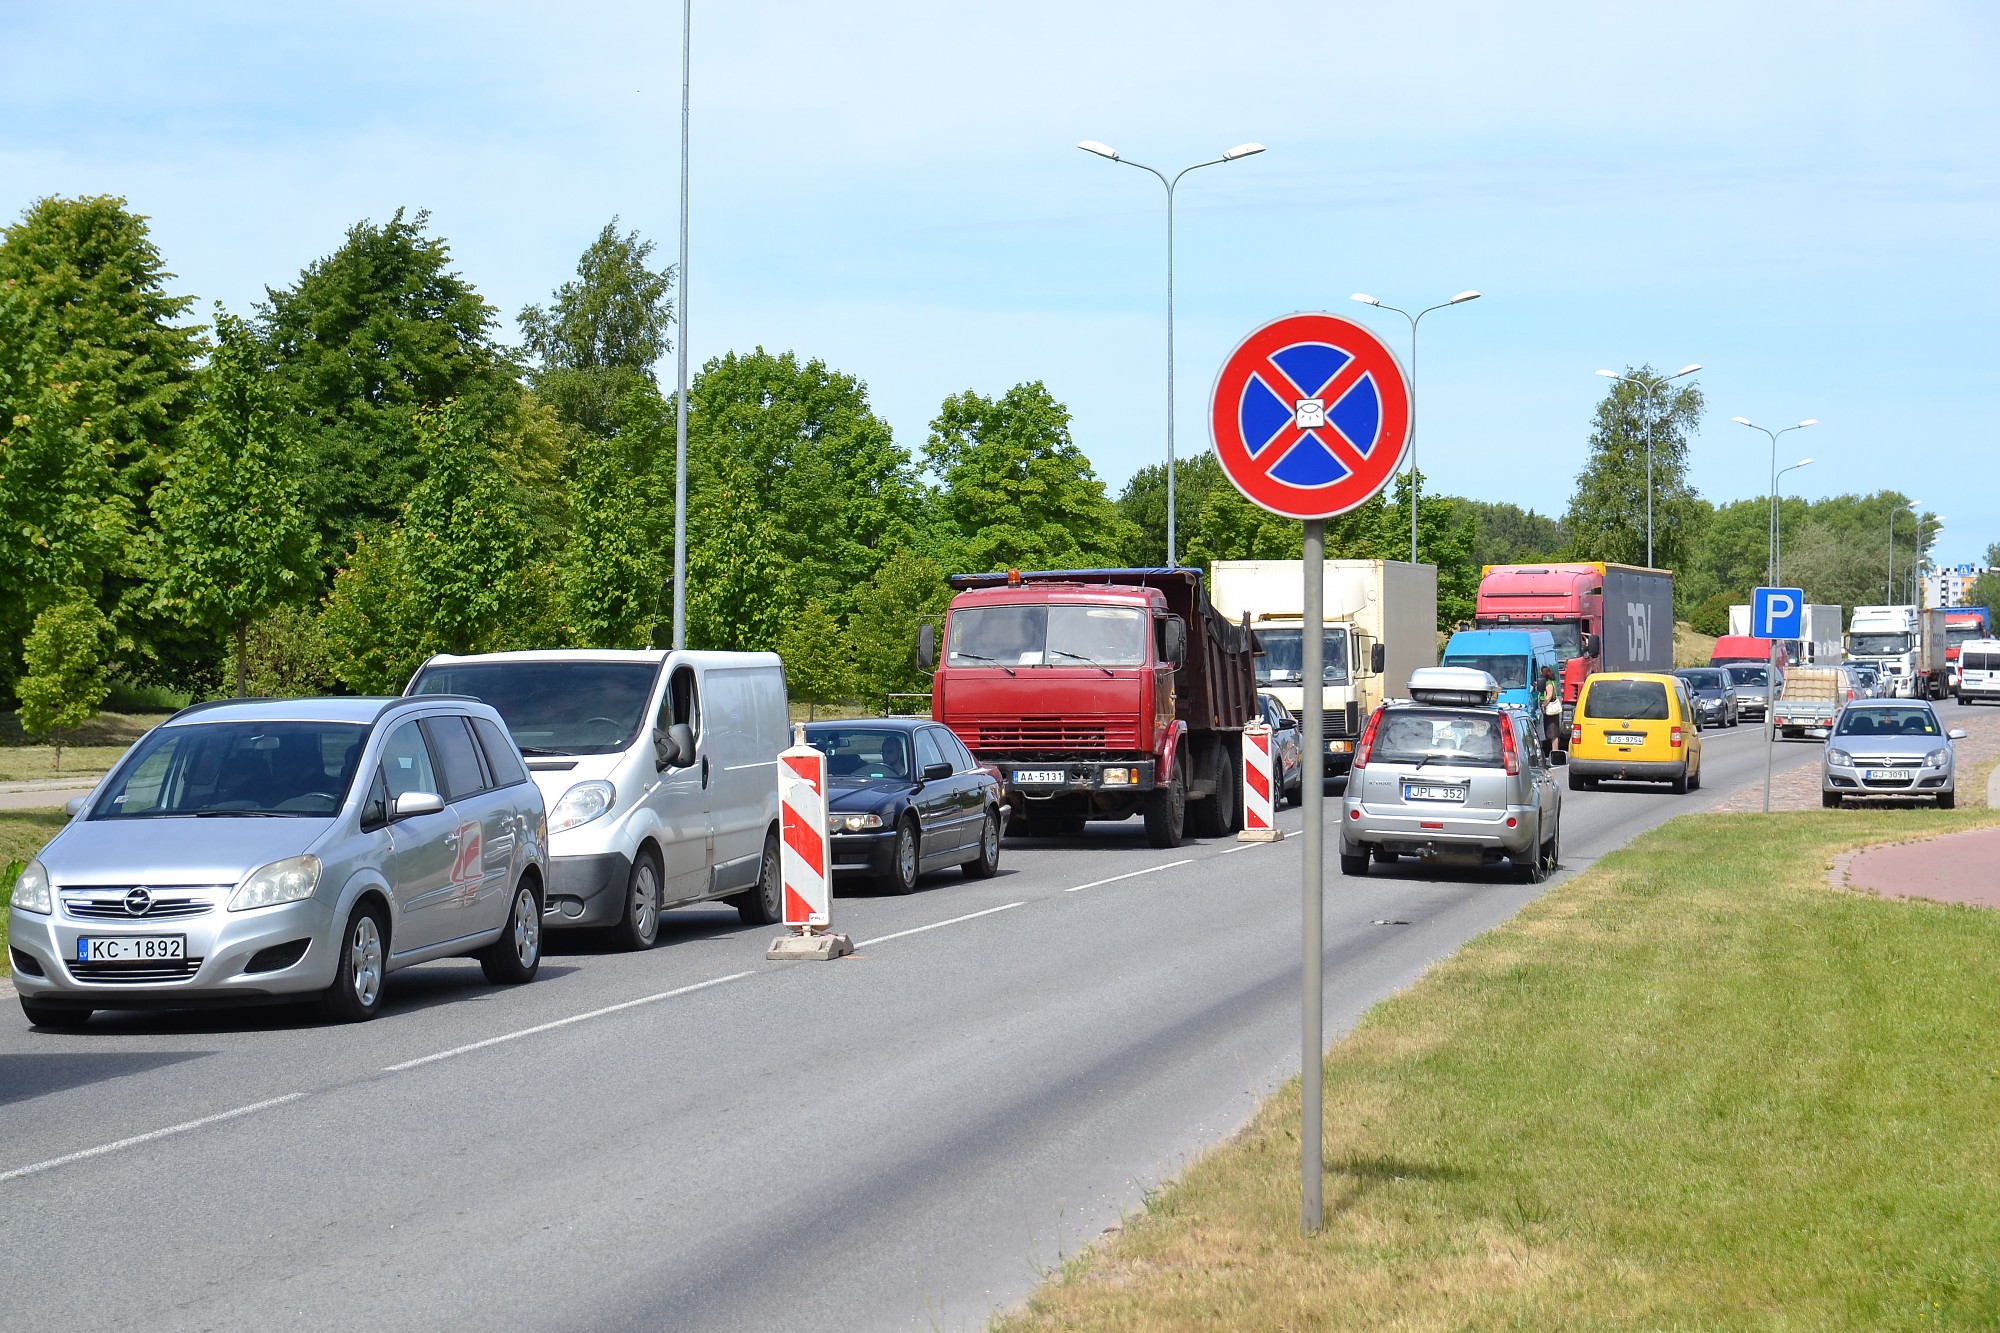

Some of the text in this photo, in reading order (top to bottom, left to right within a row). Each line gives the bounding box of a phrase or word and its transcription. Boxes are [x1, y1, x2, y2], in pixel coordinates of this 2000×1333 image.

[1765, 594, 1794, 634] P
[1627, 602, 1651, 662] DSV
[1020, 772, 1062, 781] AA-5131
[1412, 787, 1462, 799] JPL 352
[93, 940, 181, 959] KC-1892
